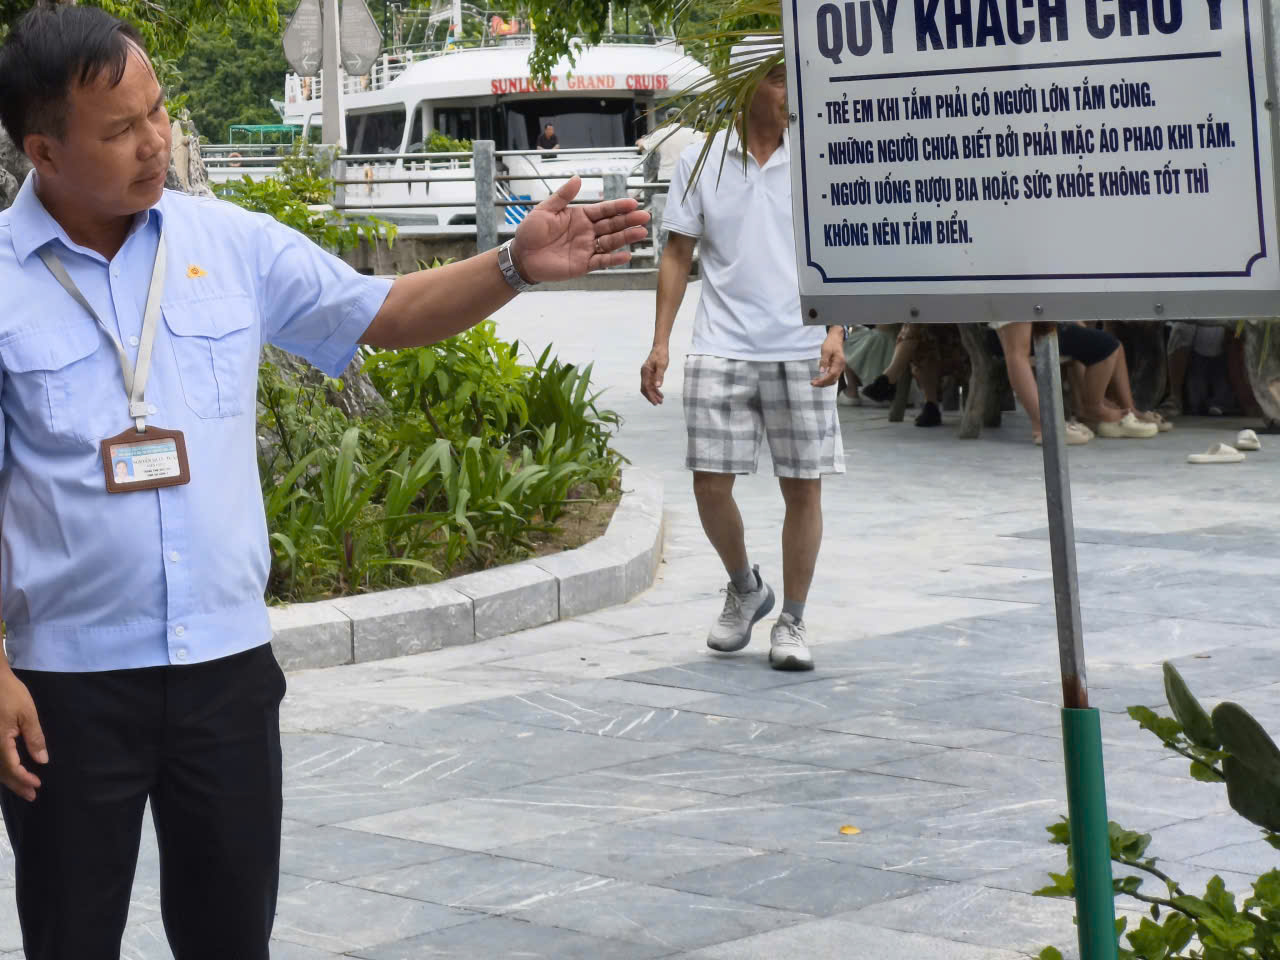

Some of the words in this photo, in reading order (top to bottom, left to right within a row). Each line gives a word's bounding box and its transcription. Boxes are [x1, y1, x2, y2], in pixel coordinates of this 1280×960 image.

[567, 74, 616, 90] GRAND
[626, 74, 669, 90] CRUISE
[825, 92, 850, 125] TRẺ
[853, 98, 874, 123] EM
[877, 97, 900, 122] KHI
[903, 87, 932, 120] TẮM
[935, 85, 968, 118] PHẢI
[971, 86, 990, 117] CÓ
[993, 83, 1038, 116] NGƯỜI
[1040, 82, 1070, 113] LỚN
[1073, 76, 1106, 111] TẮM
[1109, 78, 1156, 109] CÙNG.
[828, 136, 874, 165] NHỮNG
[877, 132, 919, 163] NGƯỜI
[922, 133, 960, 161] CHƯA
[962, 126, 992, 159] BIẾT
[1023, 123, 1058, 156] PHẢI
[1061, 124, 1095, 160] MẶC
[1099, 123, 1119, 153] ÁO
[1123, 125, 1163, 152] PHAO
[1167, 124, 1194, 150] KHI
[1196, 113, 1236, 149] TẮM.
[830, 176, 872, 206] NGƯỜI
[874, 172, 912, 204] UỐNG
[915, 176, 952, 208] RƯỢU
[955, 177, 979, 201] BIA
[982, 170, 1019, 205] HOẶC
[1023, 169, 1052, 200] SỨC
[1056, 164, 1095, 198] KHỎE
[1098, 166, 1151, 197] KHÔNG
[1153, 160, 1181, 195] TỐT
[1184, 162, 1209, 194] THÌ
[824, 218, 869, 247] KHÔNG
[872, 217, 901, 246] NÊN
[903, 212, 933, 245] TẮM
[936, 210, 973, 244] BIỂN.
